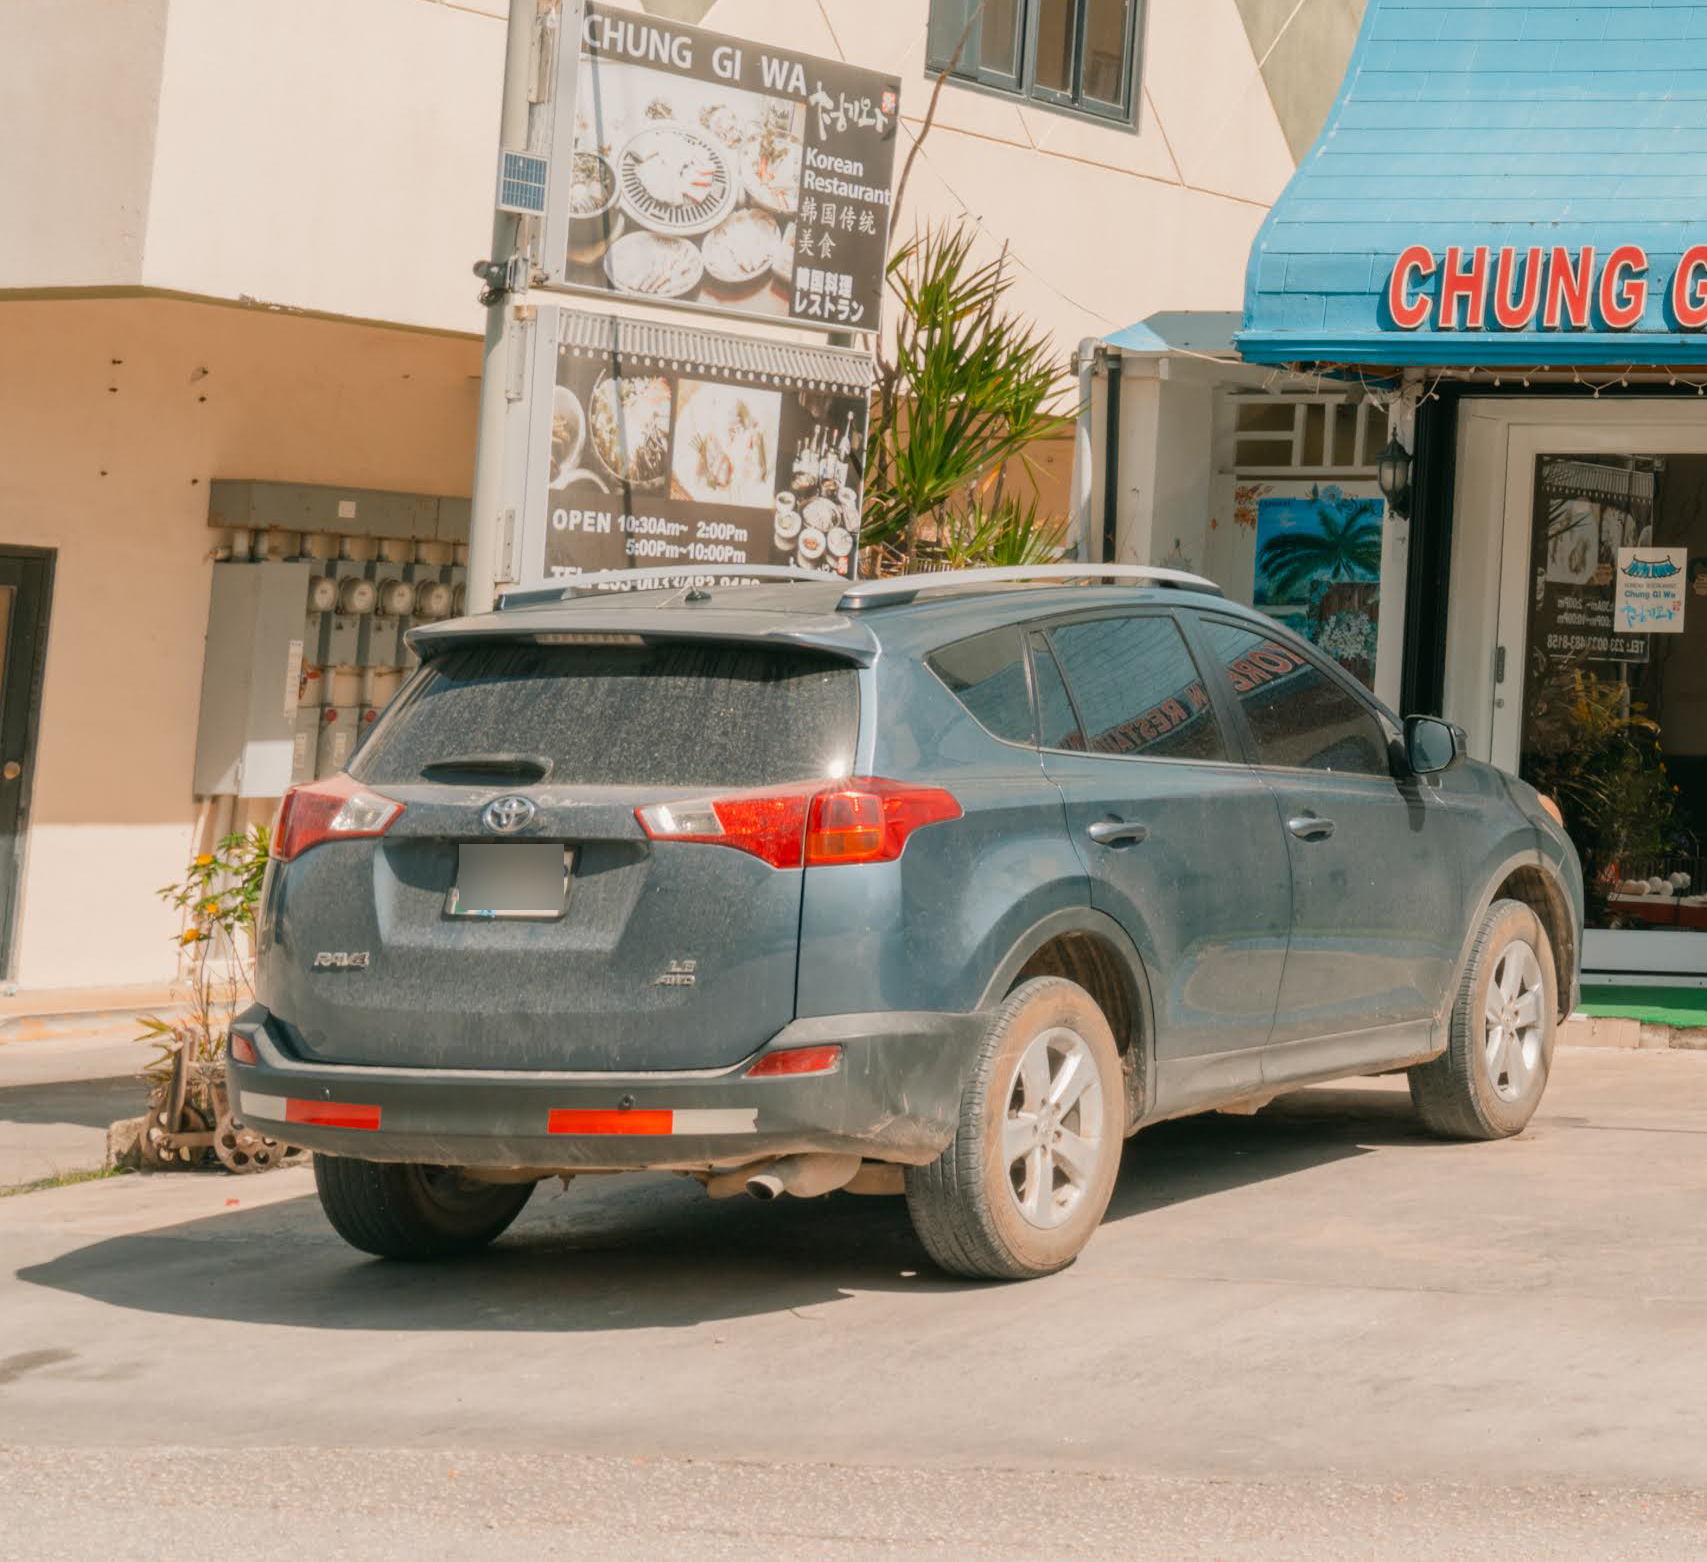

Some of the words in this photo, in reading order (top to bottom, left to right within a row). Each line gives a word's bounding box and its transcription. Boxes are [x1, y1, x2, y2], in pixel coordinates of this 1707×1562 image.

[581, 14, 693, 69] CHUNG
[711, 46, 742, 81] GI
[761, 55, 807, 96] WA
[805, 147, 864, 178] Korean
[803, 170, 892, 206] Restaurant
[798, 228, 836, 259] 美食
[1388, 245, 1649, 330] CHUNG
[793, 291, 865, 324] レストラン
[551, 510, 611, 534] OPEN
[695, 521, 749, 543] 2:00Pm
[1624, 590, 1650, 600] Chung
